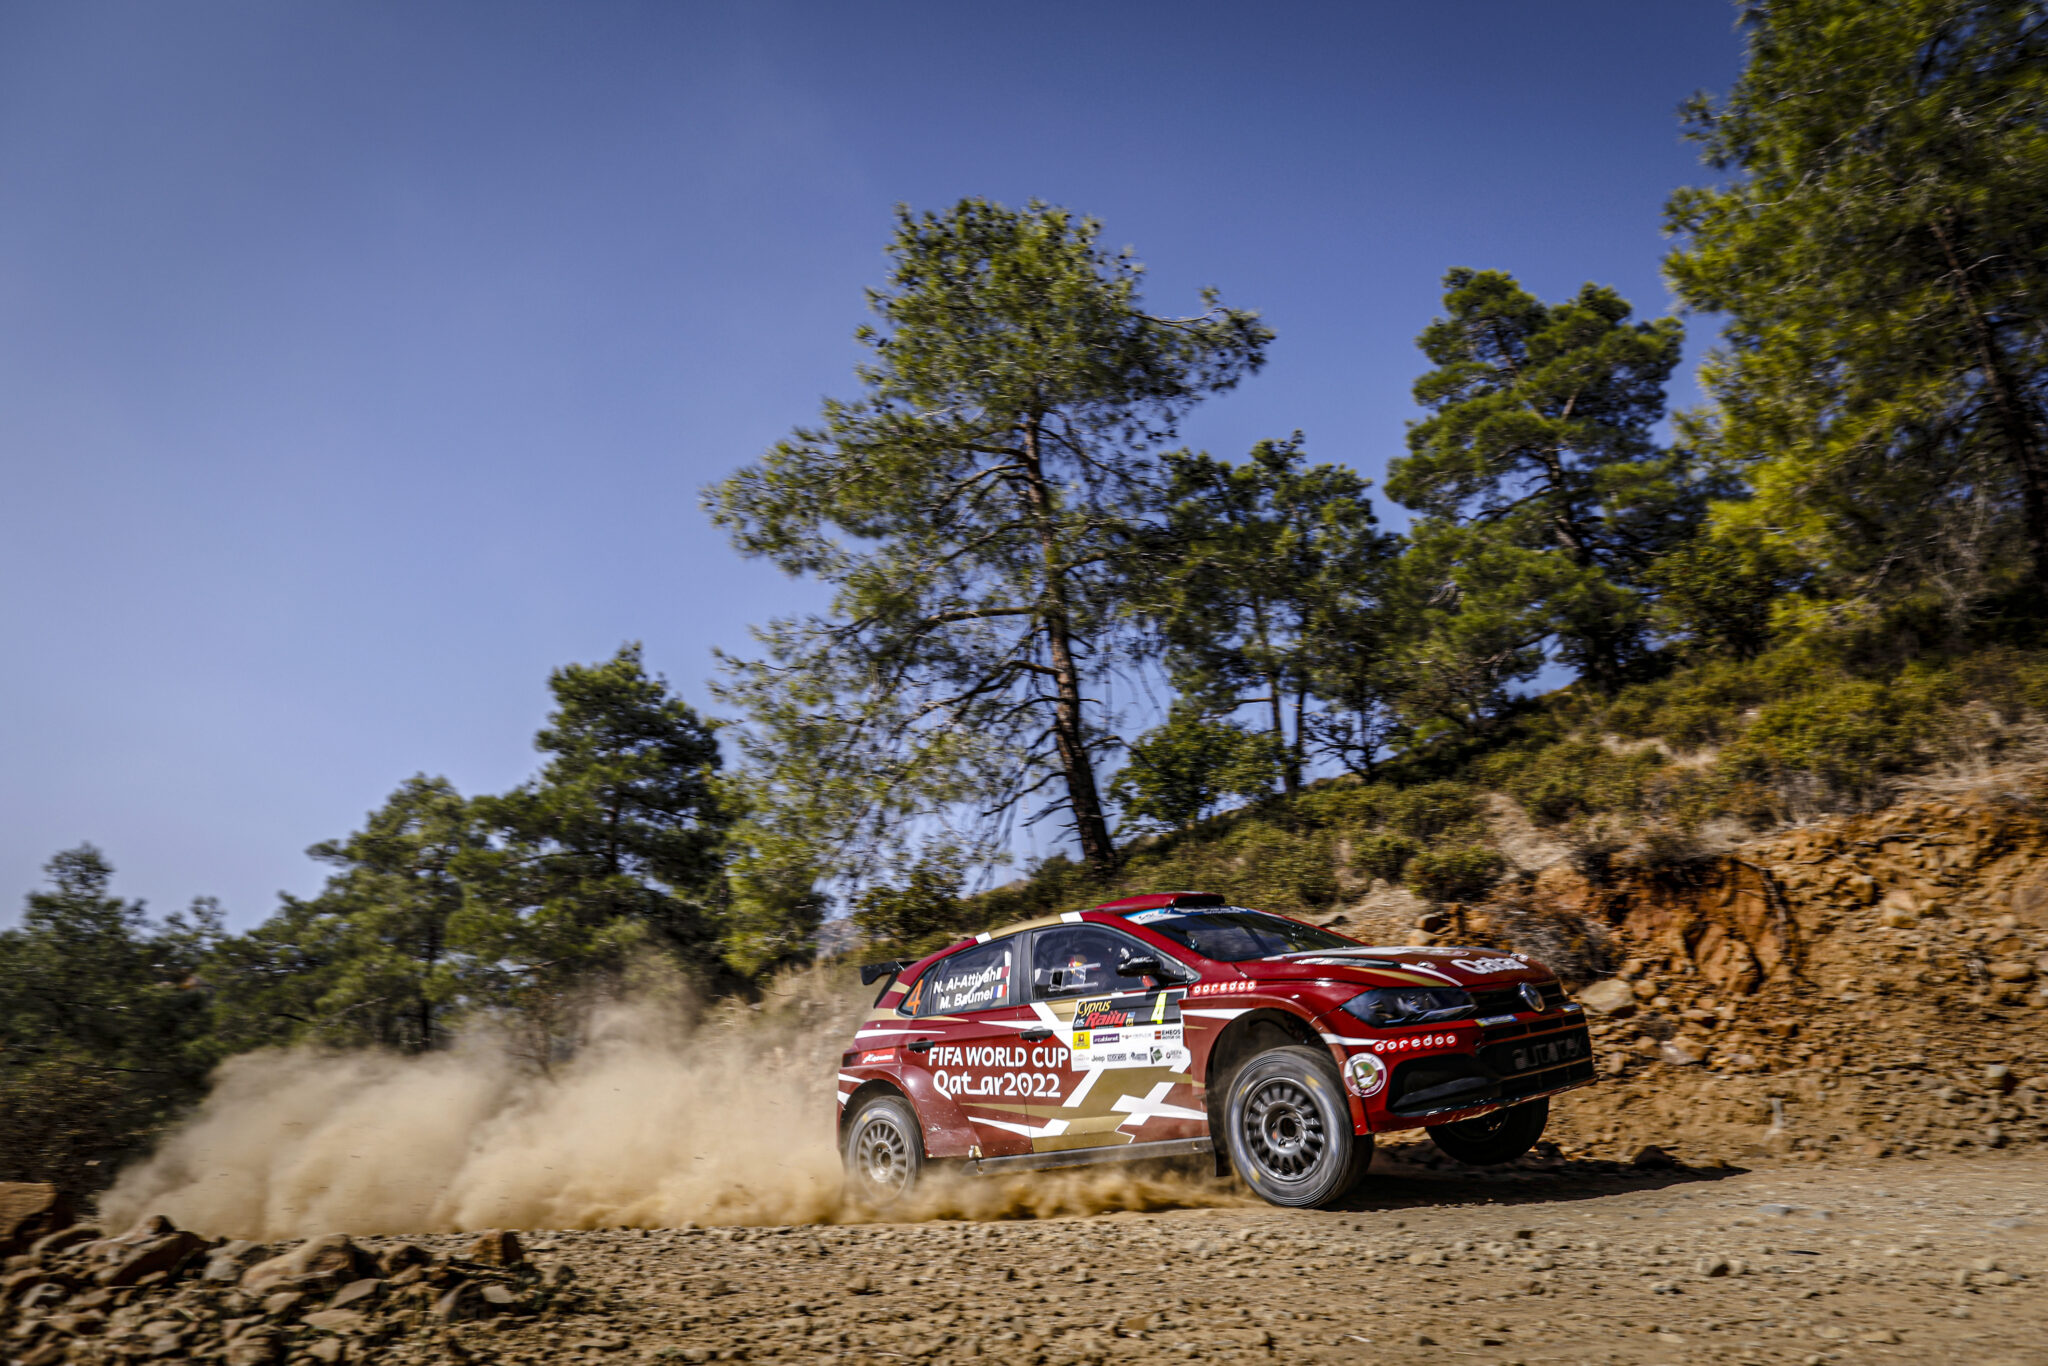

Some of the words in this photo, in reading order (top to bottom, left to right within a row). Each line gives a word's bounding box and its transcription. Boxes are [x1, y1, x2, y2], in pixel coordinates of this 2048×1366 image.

[933, 981, 944, 994] N.
[946, 968, 998, 991] Al-Attiyah
[1192, 980, 1257, 996] ooredoo
[906, 979, 924, 1015] 4
[940, 996, 951, 1010] M.
[954, 985, 994, 1007] Baumel
[1078, 1000, 1112, 1017] Cyprus
[1151, 992, 1168, 1025] 4
[1084, 1010, 1128, 1029] Rally
[1161, 1029, 1181, 1037] ENEOS
[1373, 1033, 1457, 1054] ooredoo
[928, 1046, 963, 1066] FIFA
[966, 1046, 1027, 1067] WORLD
[1032, 1047, 1069, 1068] CUP
